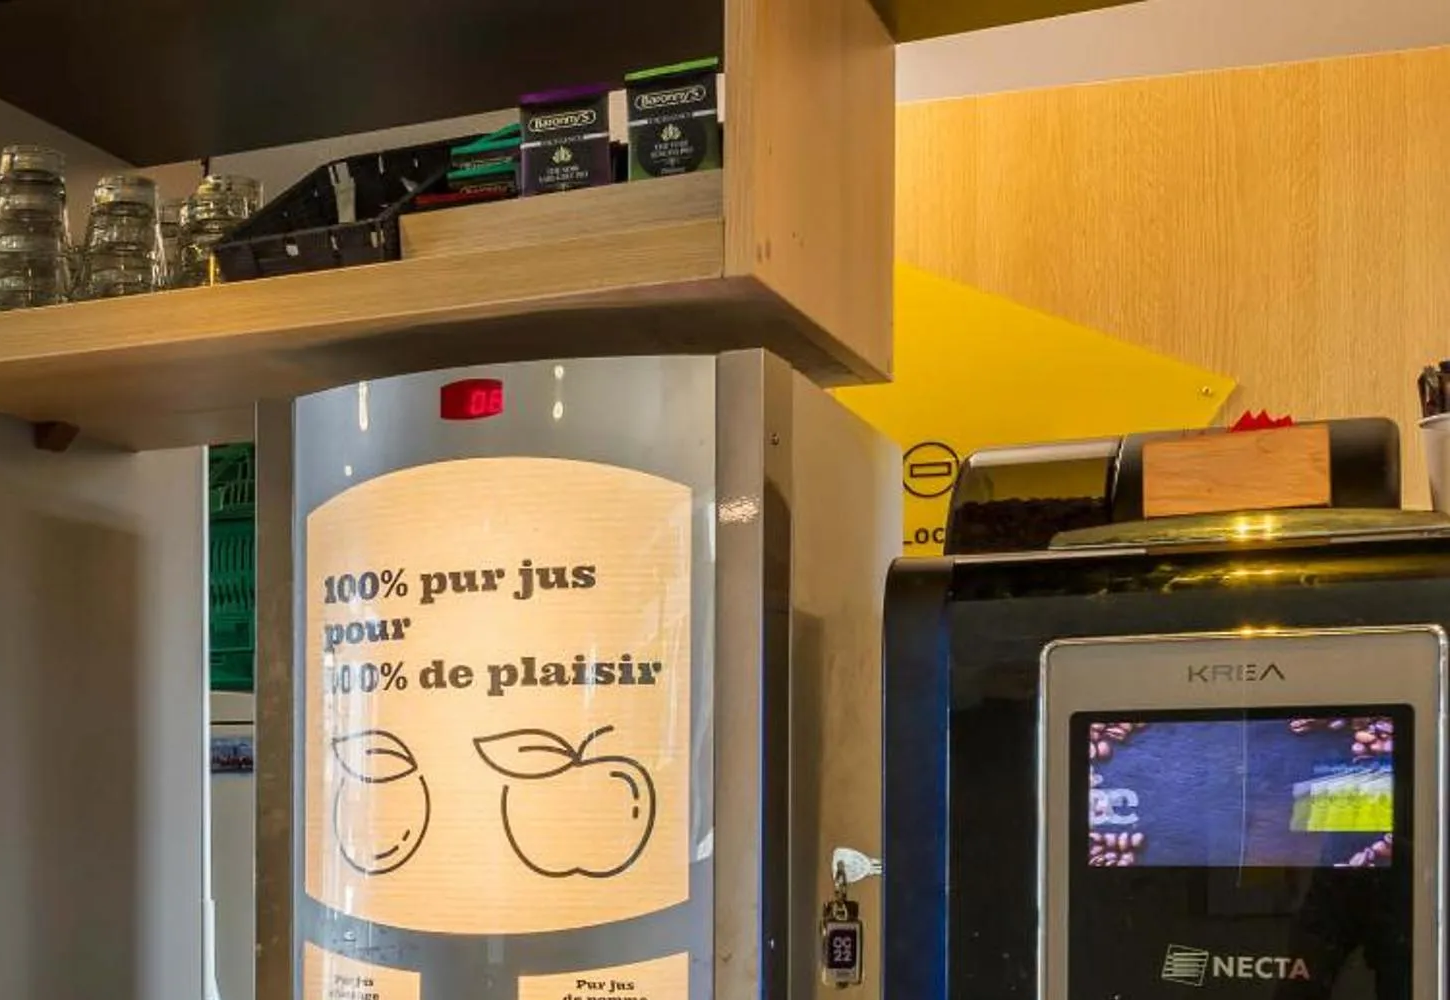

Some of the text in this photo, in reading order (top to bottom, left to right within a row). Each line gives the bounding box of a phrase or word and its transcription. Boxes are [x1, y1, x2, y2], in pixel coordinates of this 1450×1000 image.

[324, 559, 596, 604] 100% pur jus
[324, 616, 411, 653] pour
[419, 660, 474, 690] de
[487, 654, 662, 696] plaisir
[576, 979, 635, 993] Pur jus
[1212, 955, 1310, 980] NECTA
